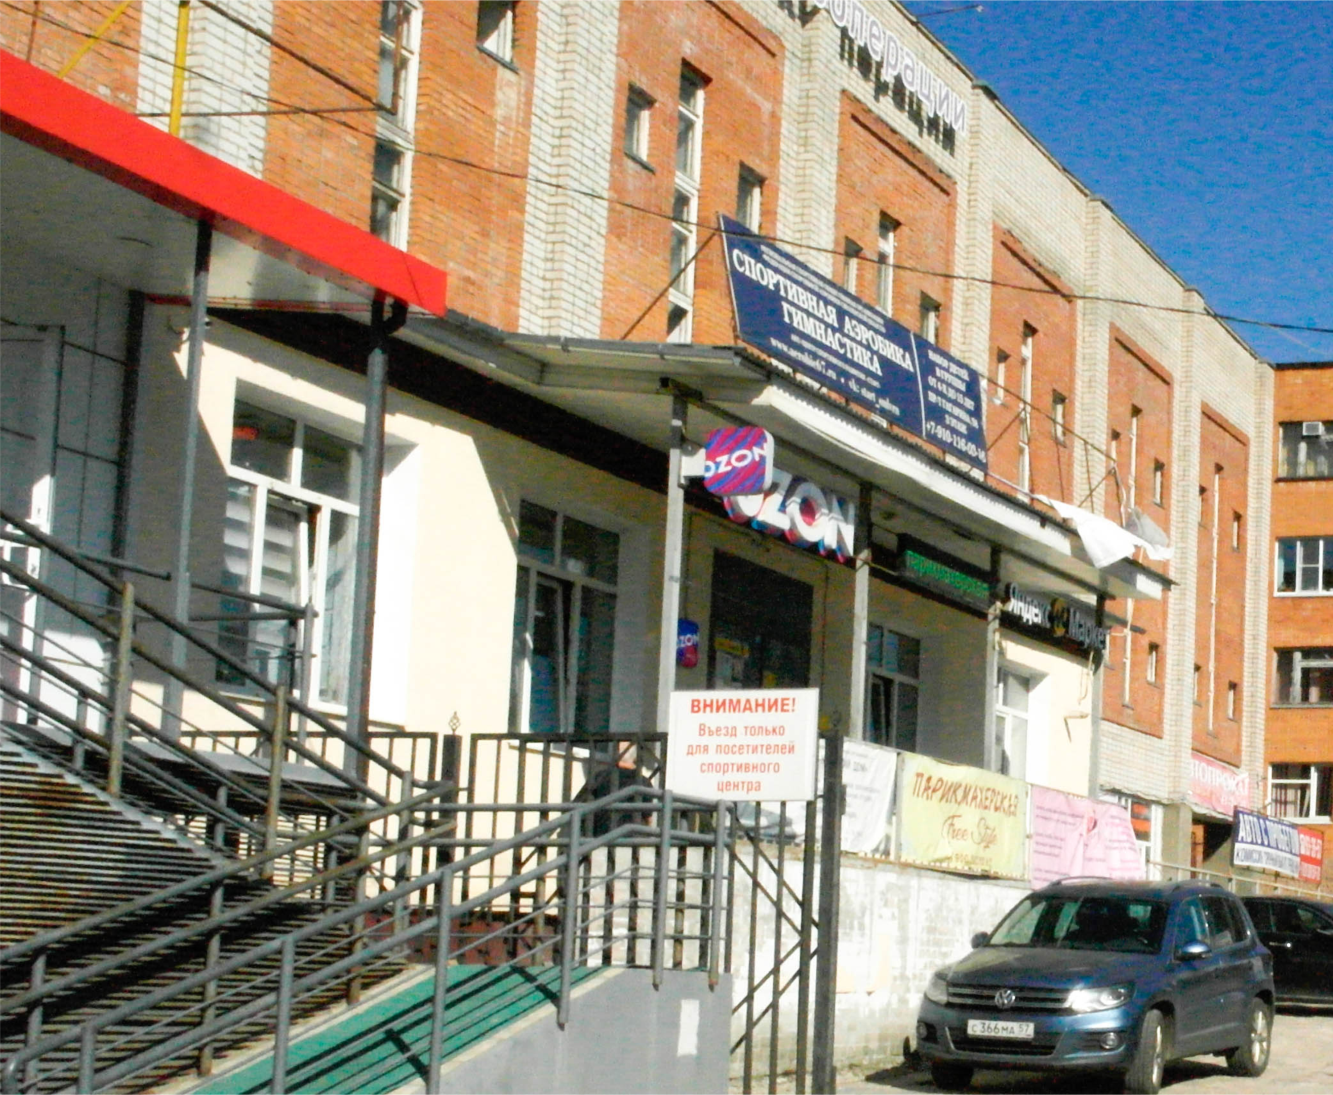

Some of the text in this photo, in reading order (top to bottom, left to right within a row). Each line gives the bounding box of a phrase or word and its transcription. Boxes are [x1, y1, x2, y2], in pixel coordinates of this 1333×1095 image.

[732, 248, 838, 328] СПОРТИВНАЯ
[844, 315, 914, 373] АЭРОБИКА
[781, 301, 882, 376] ГИМНАСТИКА
[1009, 582, 1051, 628] Яндекс
[677, 633, 699, 648] ZON
[690, 697, 796, 714] ВНИМАНИЕ!
[698, 723, 786, 738] Въезд только
[686, 741, 795, 757] для посетителей
[700, 761, 780, 776] спортивного
[717, 779, 761, 794] центра
[912, 772, 1019, 817] ПАРИКМАХЕРСКАЯ
[941, 814, 969, 844] Free
